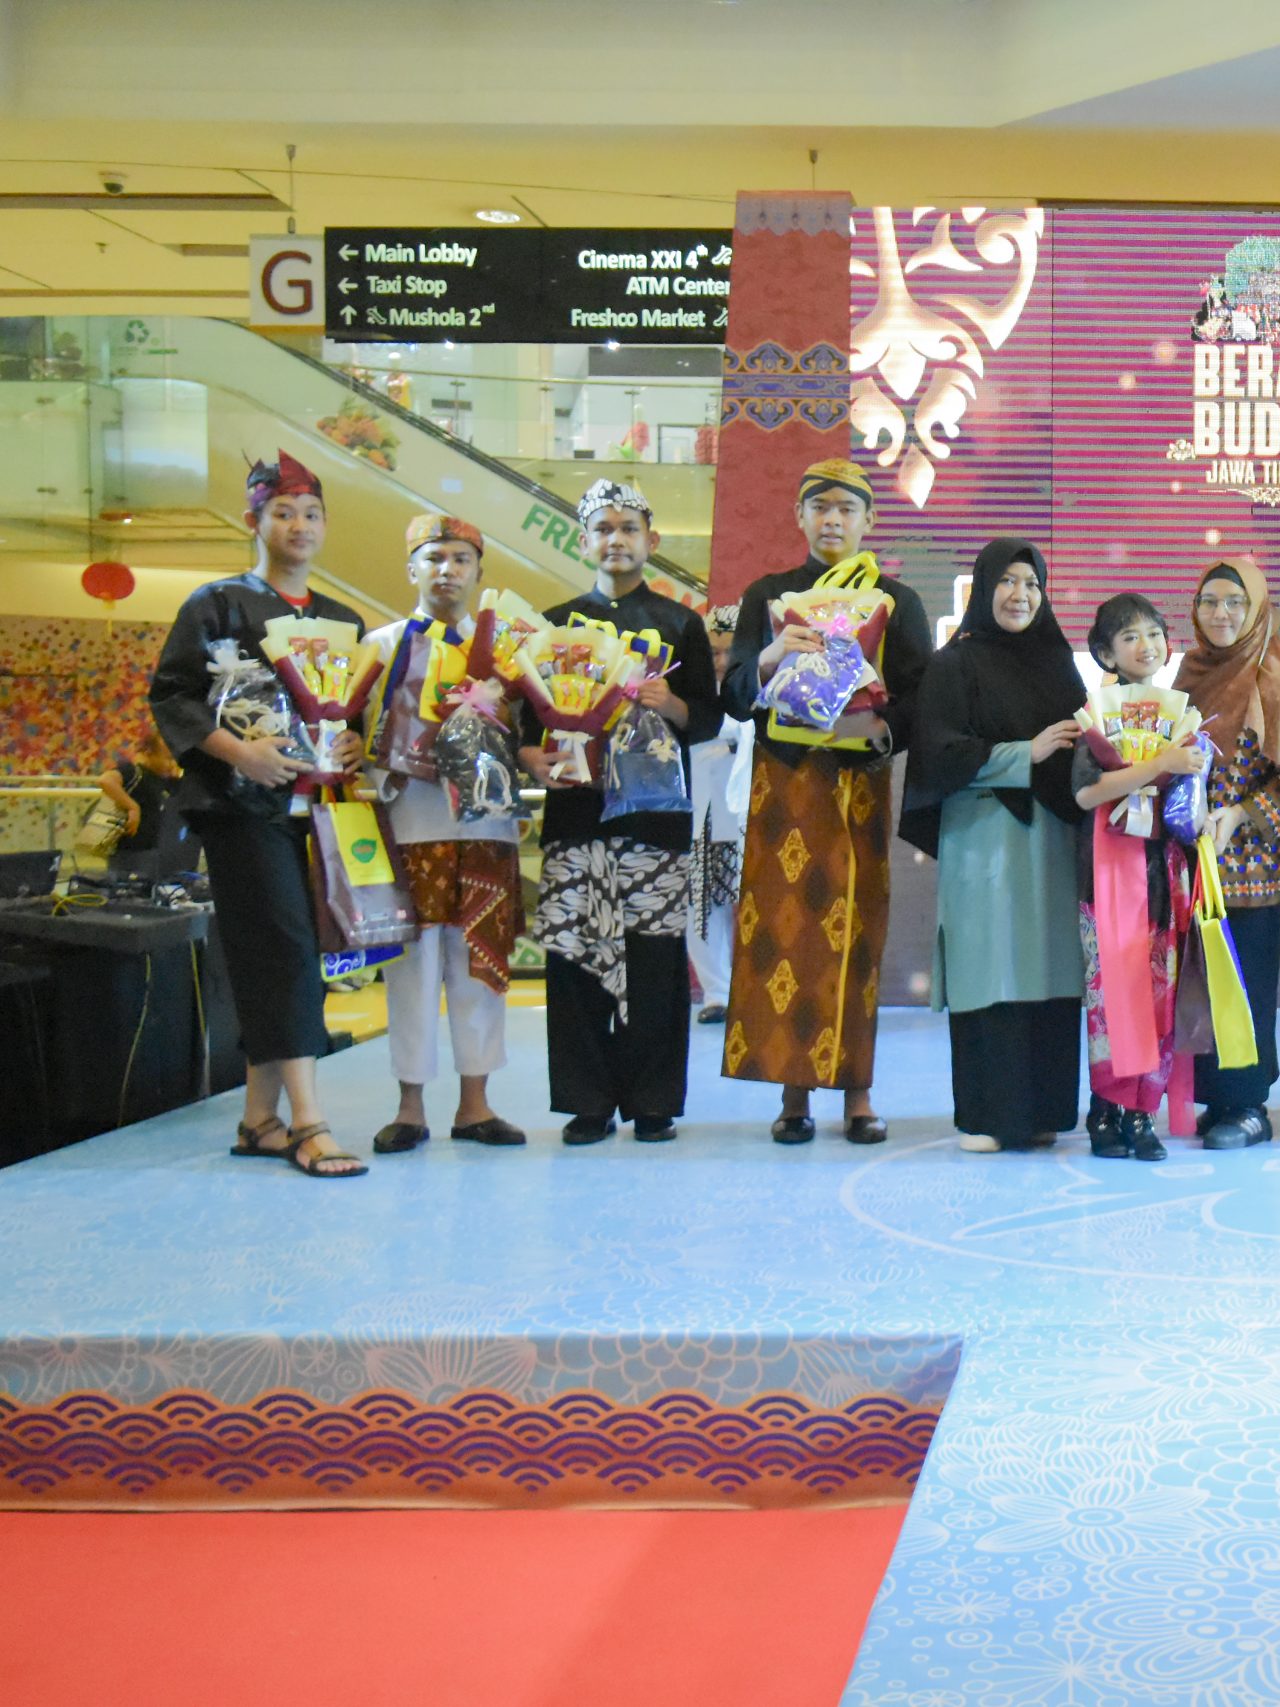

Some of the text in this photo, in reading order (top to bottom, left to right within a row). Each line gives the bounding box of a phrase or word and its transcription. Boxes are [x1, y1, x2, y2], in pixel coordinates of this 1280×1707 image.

[365, 242, 478, 267] Main Lobby
[578, 249, 647, 269] Cinema
[651, 250, 682, 269] XXI
[261, 250, 313, 315] G
[366, 275, 447, 298] Taxi Stop
[625, 276, 731, 295] ATM Center
[389, 307, 466, 326] Mushola
[571, 307, 706, 327] Freshco Market
[1206, 460, 1256, 485] JAWA
